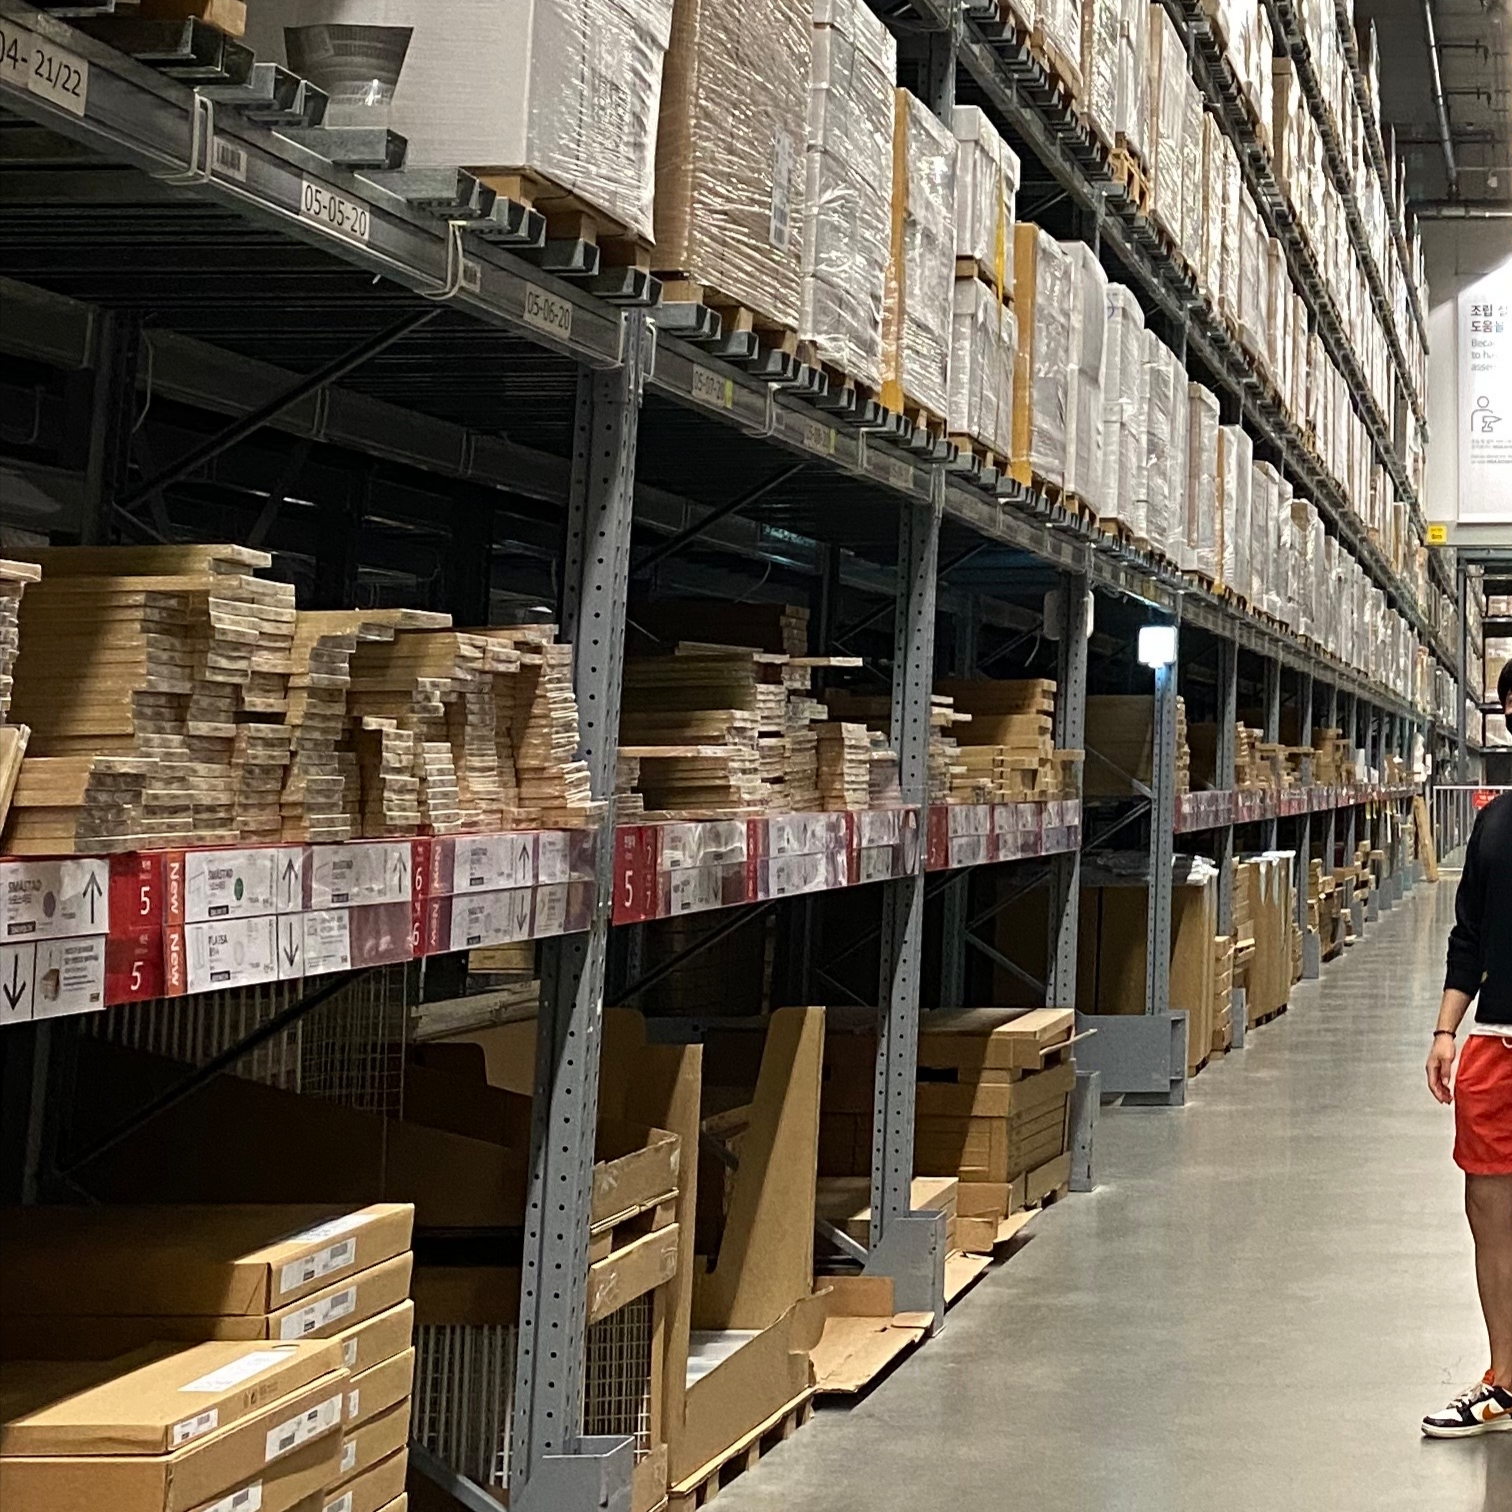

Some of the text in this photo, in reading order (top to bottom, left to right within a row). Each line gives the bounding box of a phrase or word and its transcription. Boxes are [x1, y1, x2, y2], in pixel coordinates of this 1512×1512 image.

[34, 49, 82, 97] 21/22
[304, 184, 366, 237] 05-05-20
[527, 292, 570, 331] 05-06-20
[1471, 304, 1493, 317] 조립
[170, 863, 180, 914] New
[415, 867, 423, 891] 6
[624, 869, 634, 908] 5
[140, 886, 151, 915] 5
[130, 961, 144, 991] 5
[170, 934, 180, 986] New
